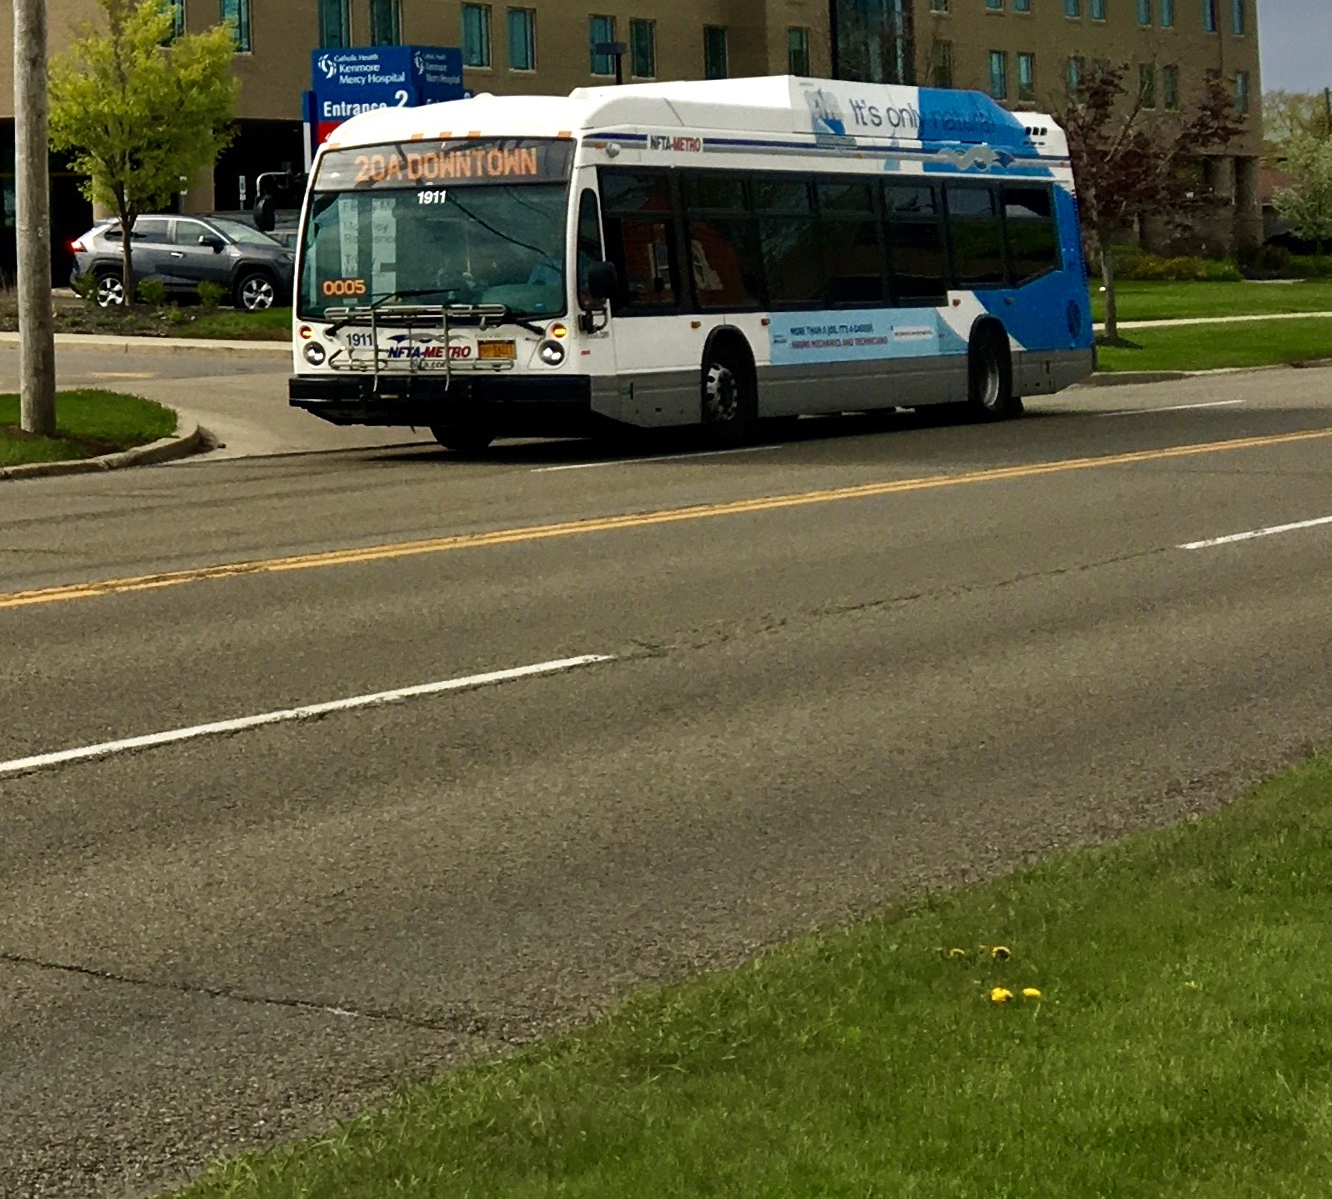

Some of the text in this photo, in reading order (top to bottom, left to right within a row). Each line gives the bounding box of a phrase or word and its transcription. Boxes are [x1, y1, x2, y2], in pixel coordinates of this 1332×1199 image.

[339, 63, 381, 74] Kenmore
[339, 71, 406, 86] Mercy Hospital
[394, 90, 408, 108] 2
[848, 98, 883, 128] It's
[354, 147, 538, 183] 20A DOWNTOWN
[417, 190, 447, 205] 1911
[322, 280, 366, 296] 0005
[346, 333, 373, 347] 1911
[387, 346, 472, 359] NFTA-METRO
